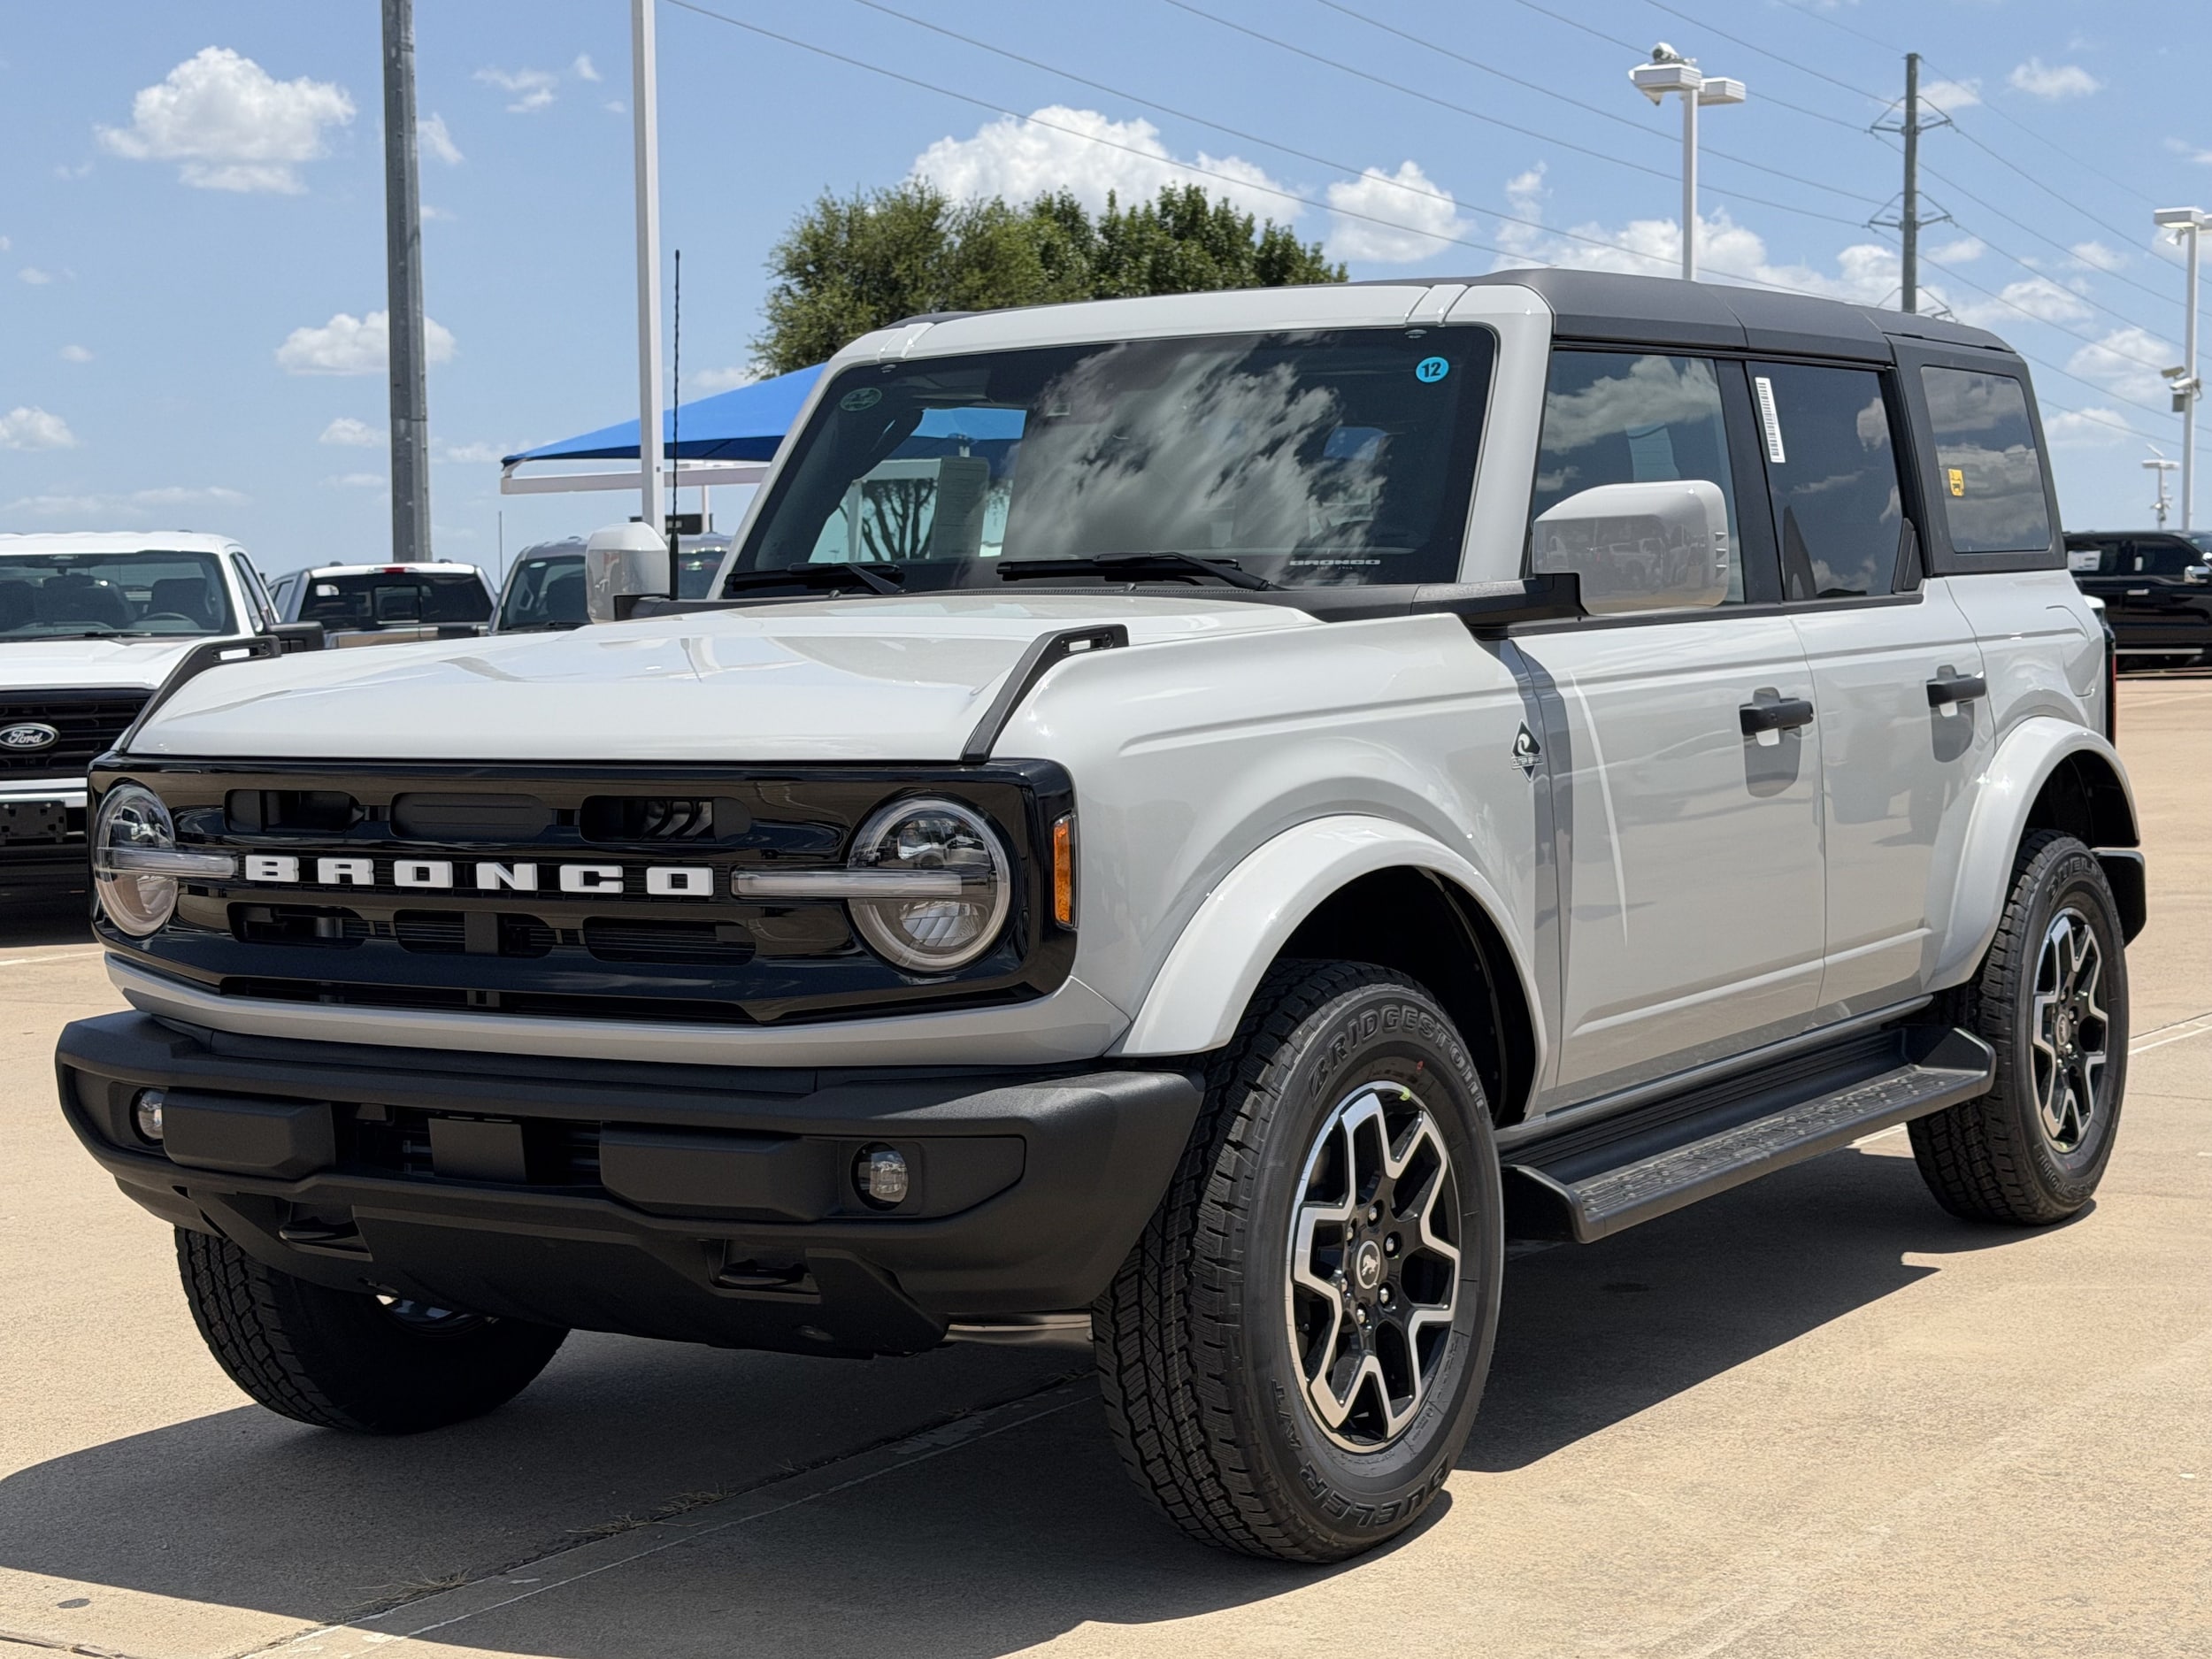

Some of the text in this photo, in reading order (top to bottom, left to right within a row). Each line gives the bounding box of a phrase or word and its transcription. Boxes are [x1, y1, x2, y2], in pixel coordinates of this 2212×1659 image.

[1421, 362, 1441, 378] 12
[7, 729, 43, 744] Ford
[245, 854, 715, 896] BRONCO
[1308, 1003, 1491, 1122] BRIDGESTONE
[1271, 1378, 1449, 1529] DUELER A/T
